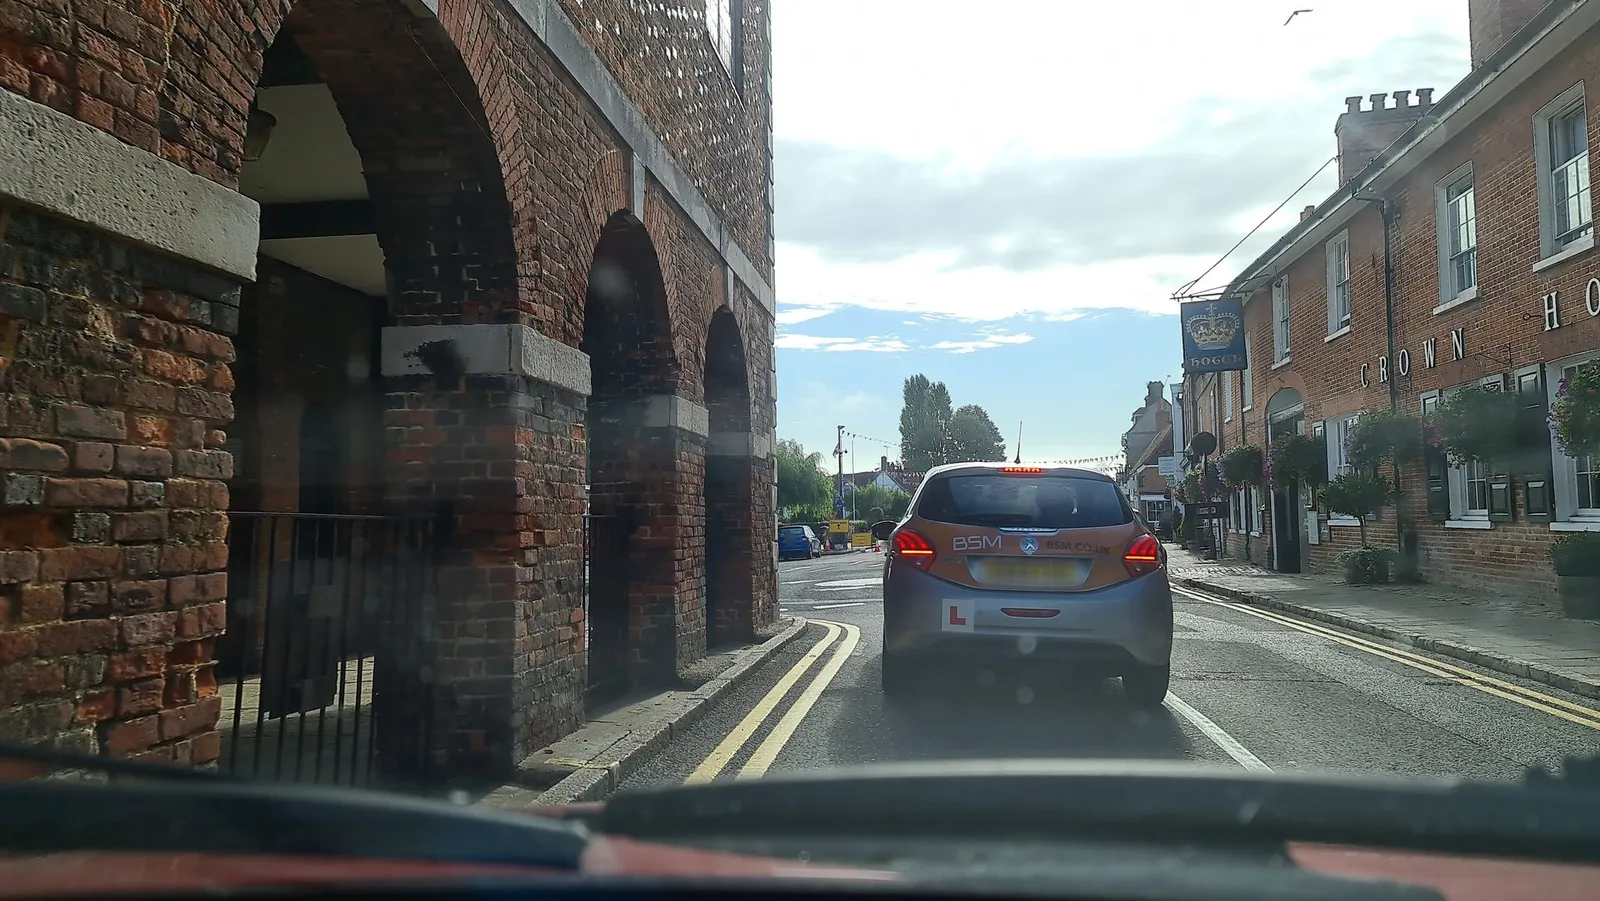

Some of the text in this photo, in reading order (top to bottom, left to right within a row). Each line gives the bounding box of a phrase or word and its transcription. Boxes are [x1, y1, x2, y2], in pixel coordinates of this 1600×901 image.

[1360, 277, 1600, 388] CROWN HO
[953, 535, 1002, 551] BSM
[1046, 540, 1111, 555] BSM.CO.UK
[949, 605, 967, 626] L
